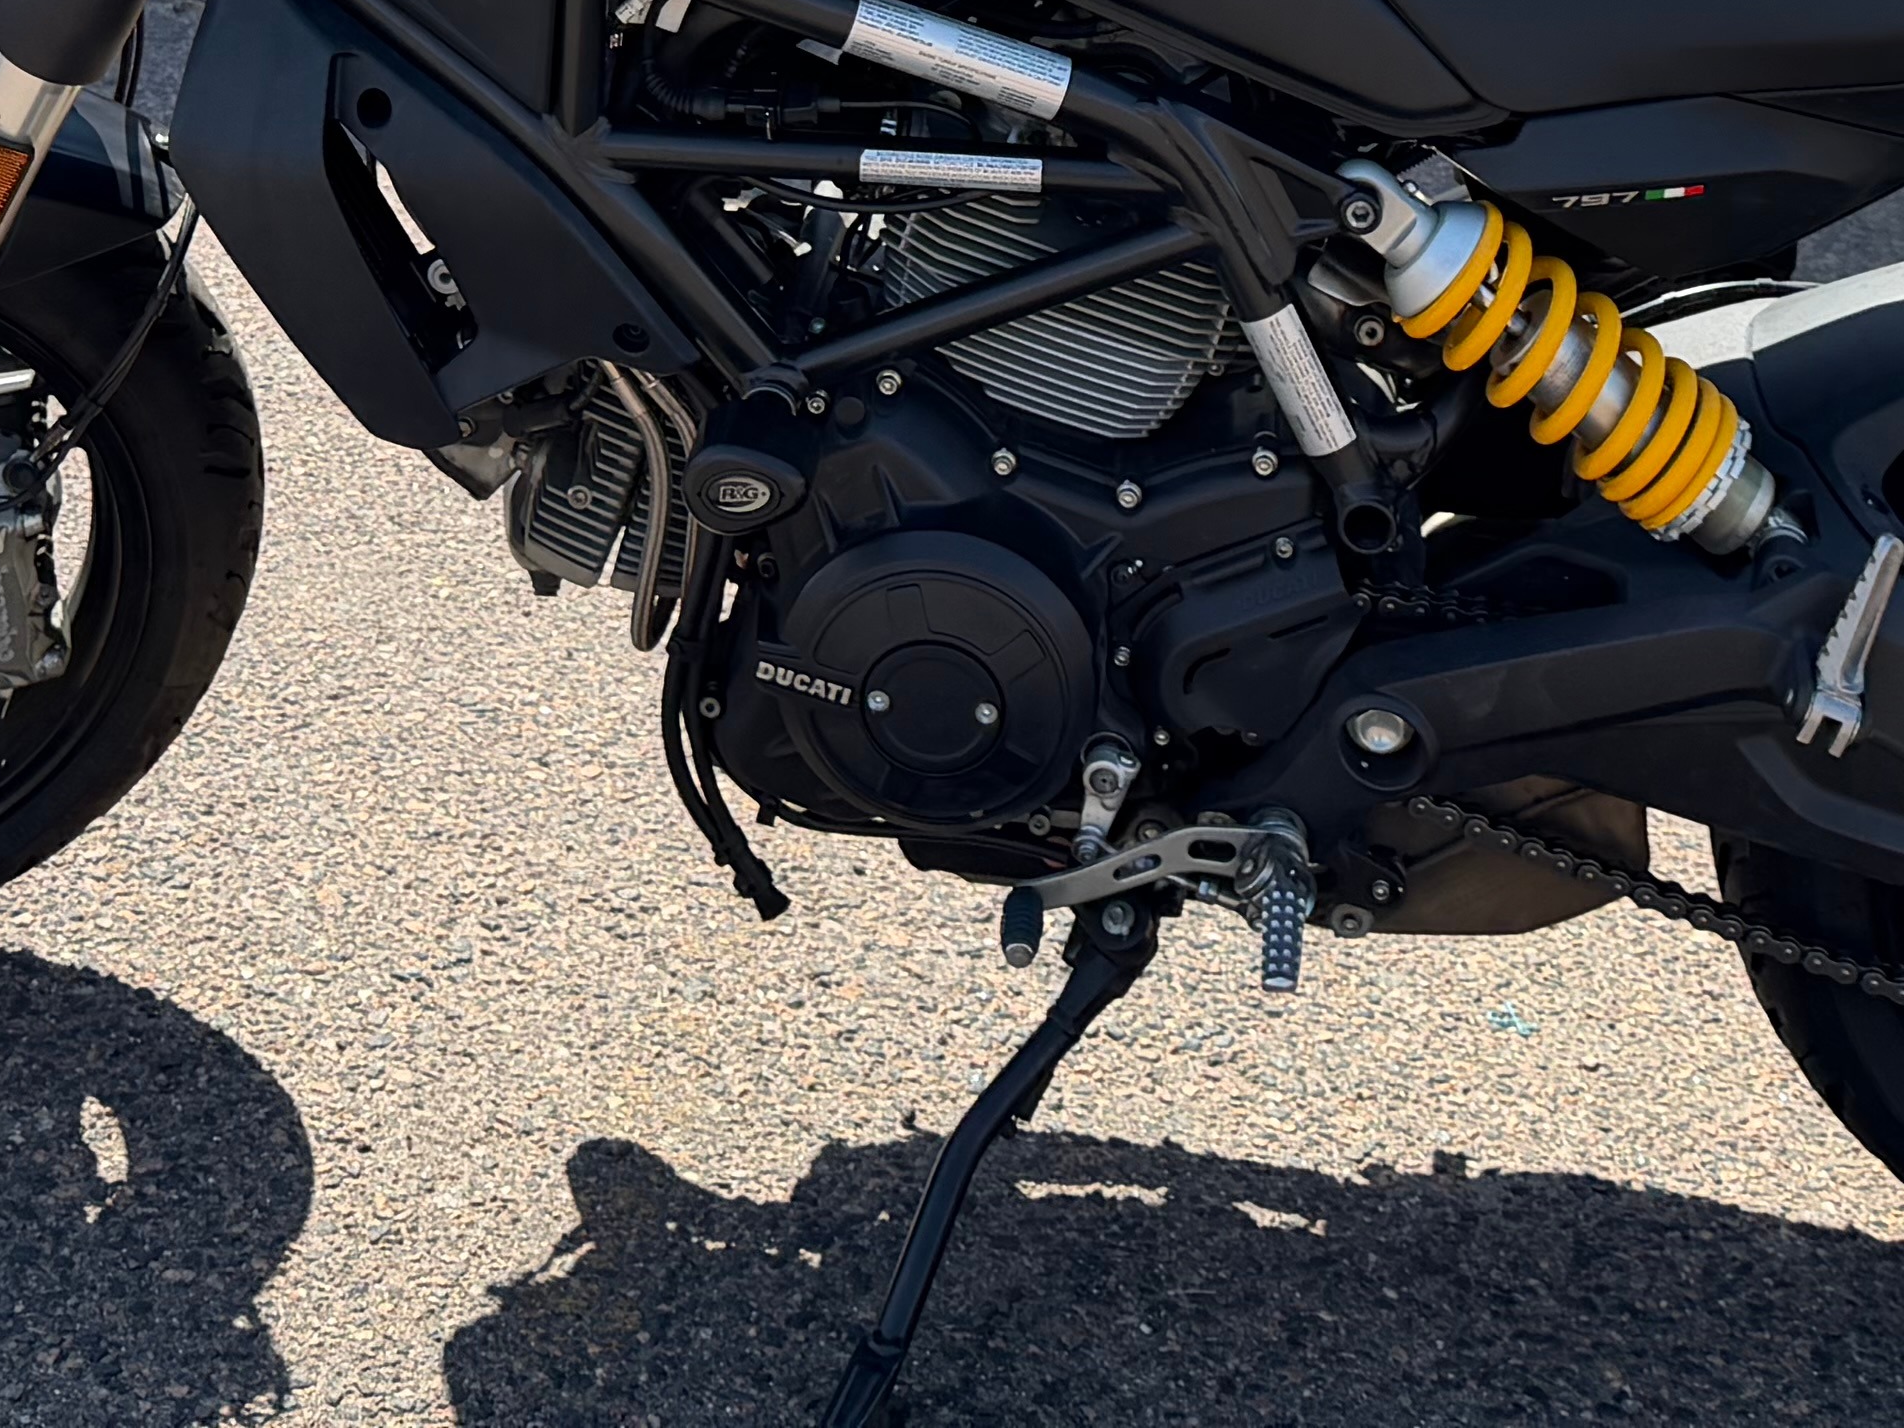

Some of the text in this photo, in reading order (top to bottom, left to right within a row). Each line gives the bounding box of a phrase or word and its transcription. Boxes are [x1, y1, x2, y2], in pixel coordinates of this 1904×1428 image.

[1552, 191, 1640, 209] 797
[721, 486, 759, 501] R&G
[756, 660, 853, 706] DUCATI
